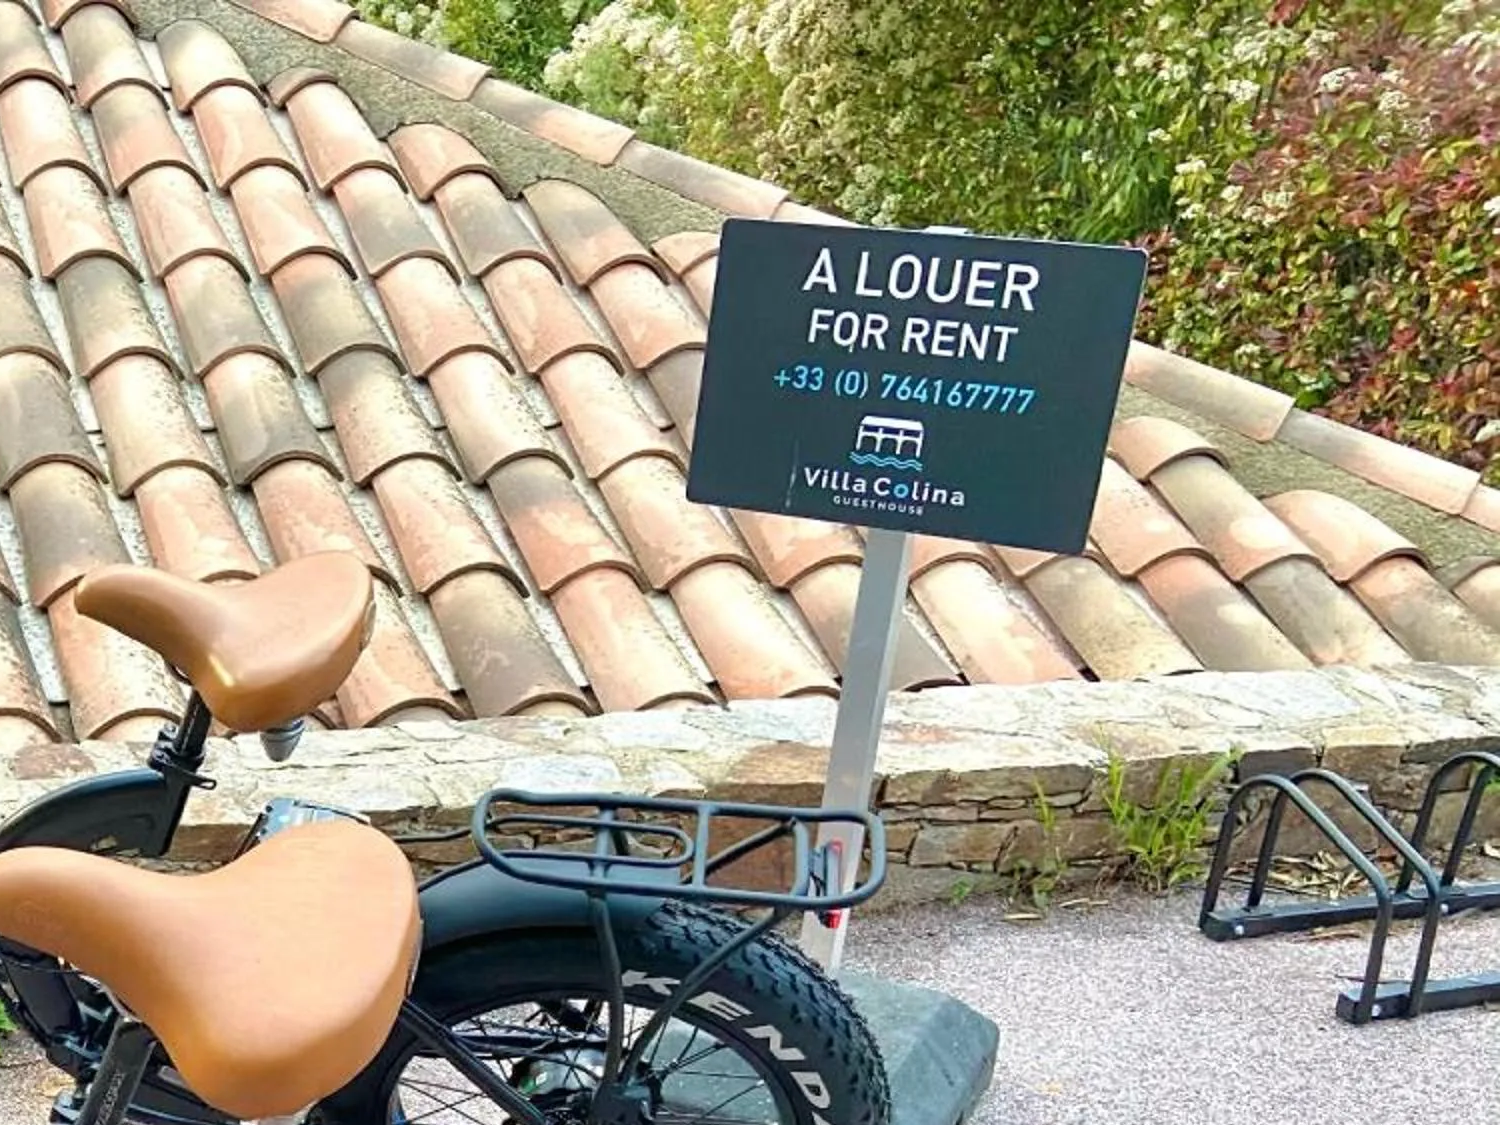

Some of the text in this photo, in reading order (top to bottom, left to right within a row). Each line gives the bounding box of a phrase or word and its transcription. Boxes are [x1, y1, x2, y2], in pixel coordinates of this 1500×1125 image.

[802, 247, 1040, 311] A LOUER
[807, 308, 1019, 362] FOR RENT
[773, 365, 1035, 414] +33 (0) 764167777
[804, 467, 966, 507] Villa Colina
[832, 495, 925, 517] GUESTHOUSE
